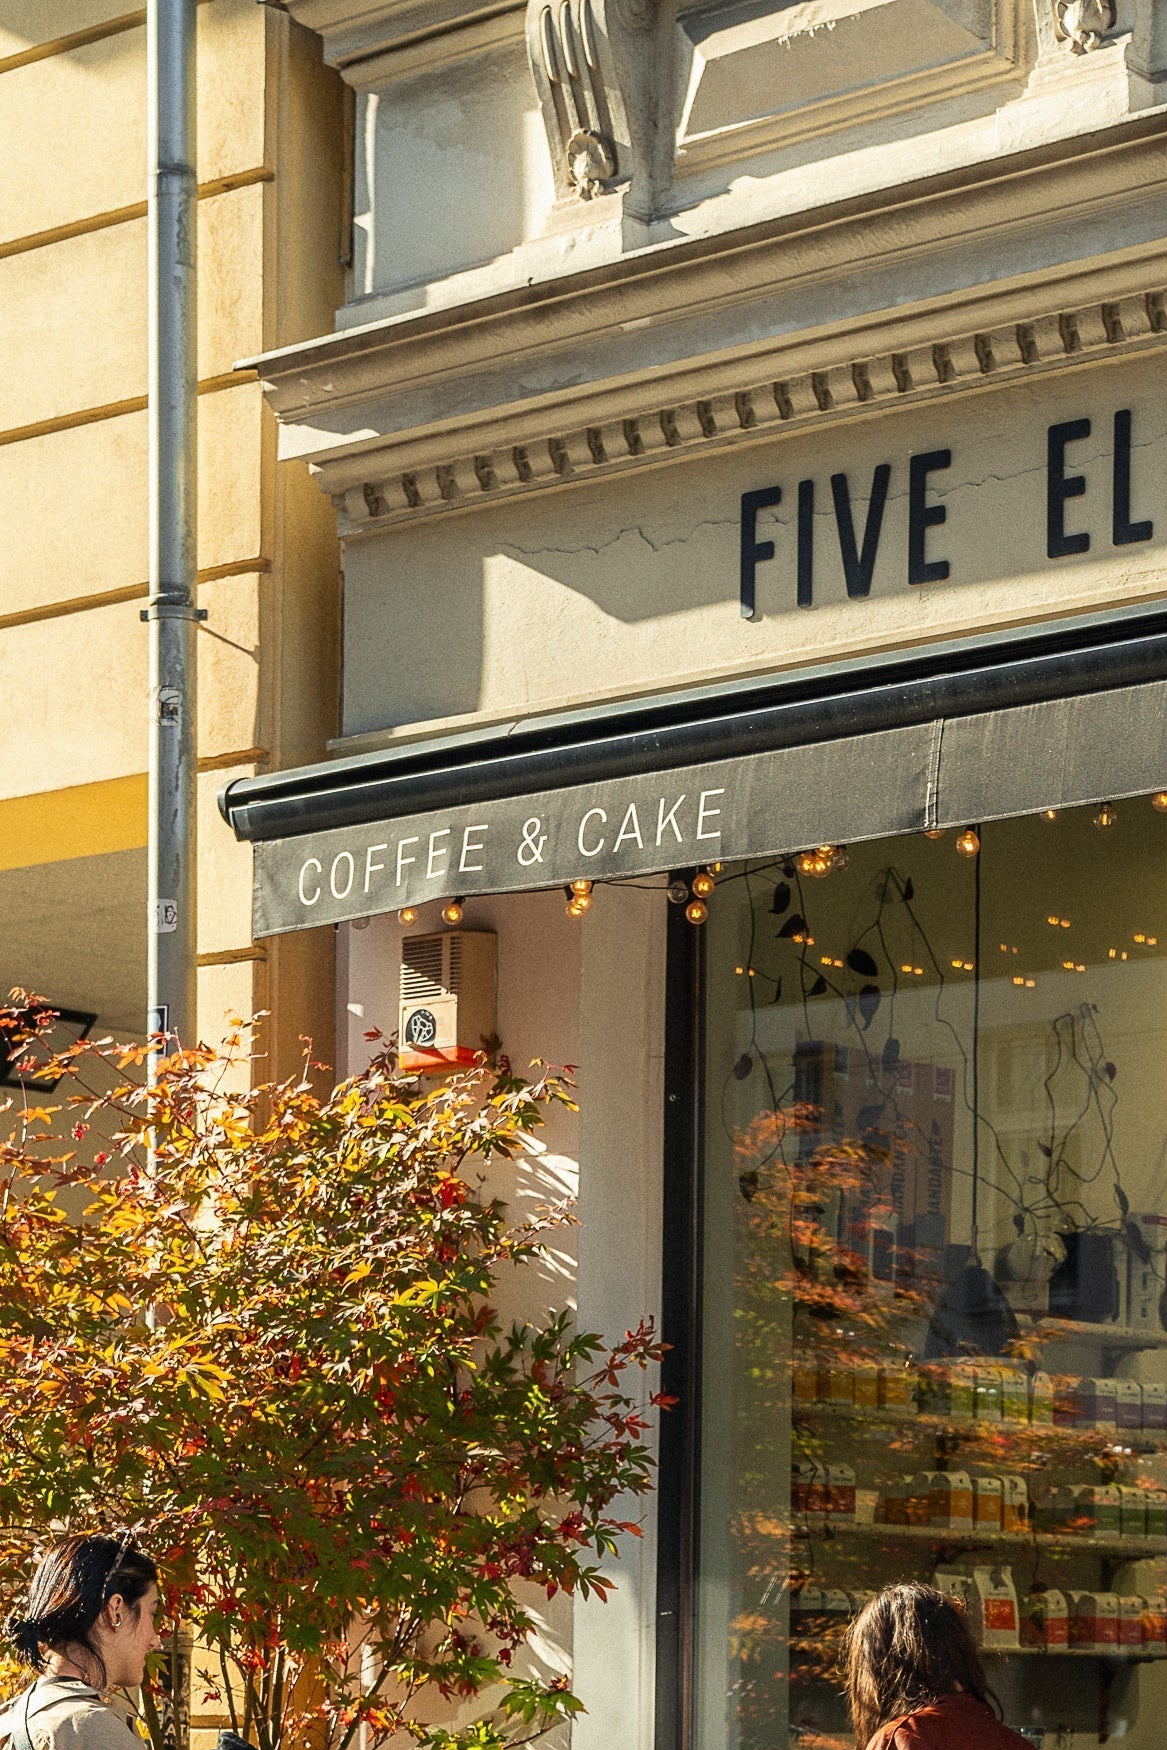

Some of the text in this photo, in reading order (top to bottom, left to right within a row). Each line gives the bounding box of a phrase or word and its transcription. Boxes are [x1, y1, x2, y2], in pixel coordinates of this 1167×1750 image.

[740, 449, 952, 618] FIVE
[298, 787, 726, 906] COFFEE & CAKE
